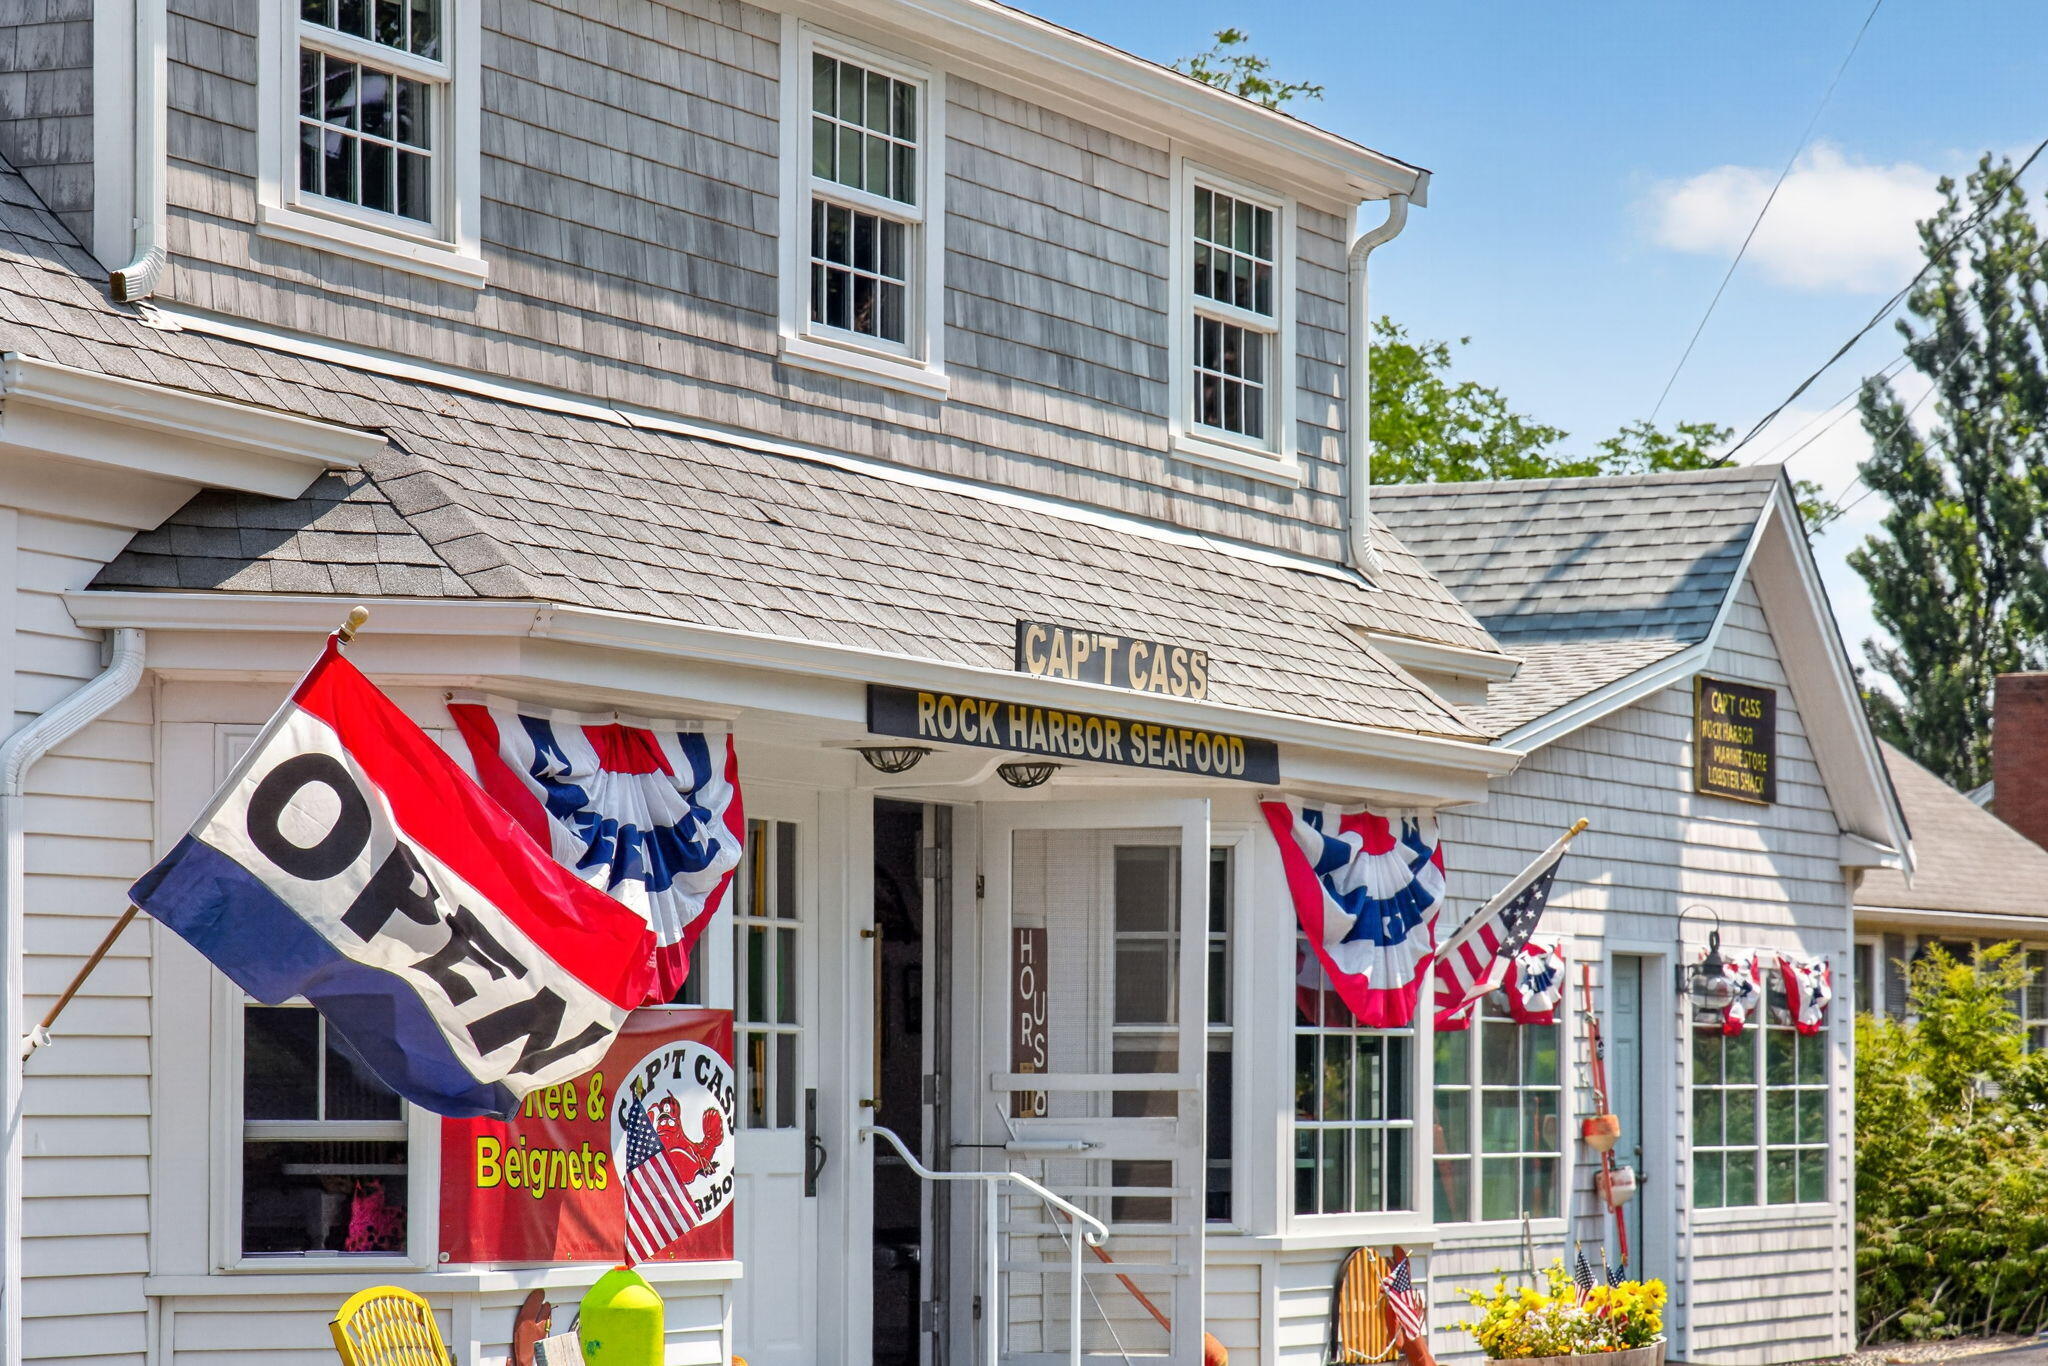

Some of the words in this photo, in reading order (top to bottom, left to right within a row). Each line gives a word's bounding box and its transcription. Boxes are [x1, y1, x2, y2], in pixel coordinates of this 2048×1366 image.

[1025, 623, 1119, 685] CAP'T
[1128, 639, 1207, 700] CASS
[917, 692, 1000, 745] ROCK
[1008, 708, 1124, 761] HARBOR
[1130, 723, 1246, 776] SEAFOOD
[1723, 722, 1753, 745] HARBOR
[1739, 697, 1762, 719] CASS
[1708, 765, 1739, 790] LOBSTER
[1740, 771, 1765, 795] SHACK
[1713, 745, 1743, 768] MARINE
[1743, 751, 1767, 772] STORE
[246, 752, 613, 1075] OPEN
[1020, 929, 1046, 1068] HOURS
[476, 1134, 608, 1200] Beignets
